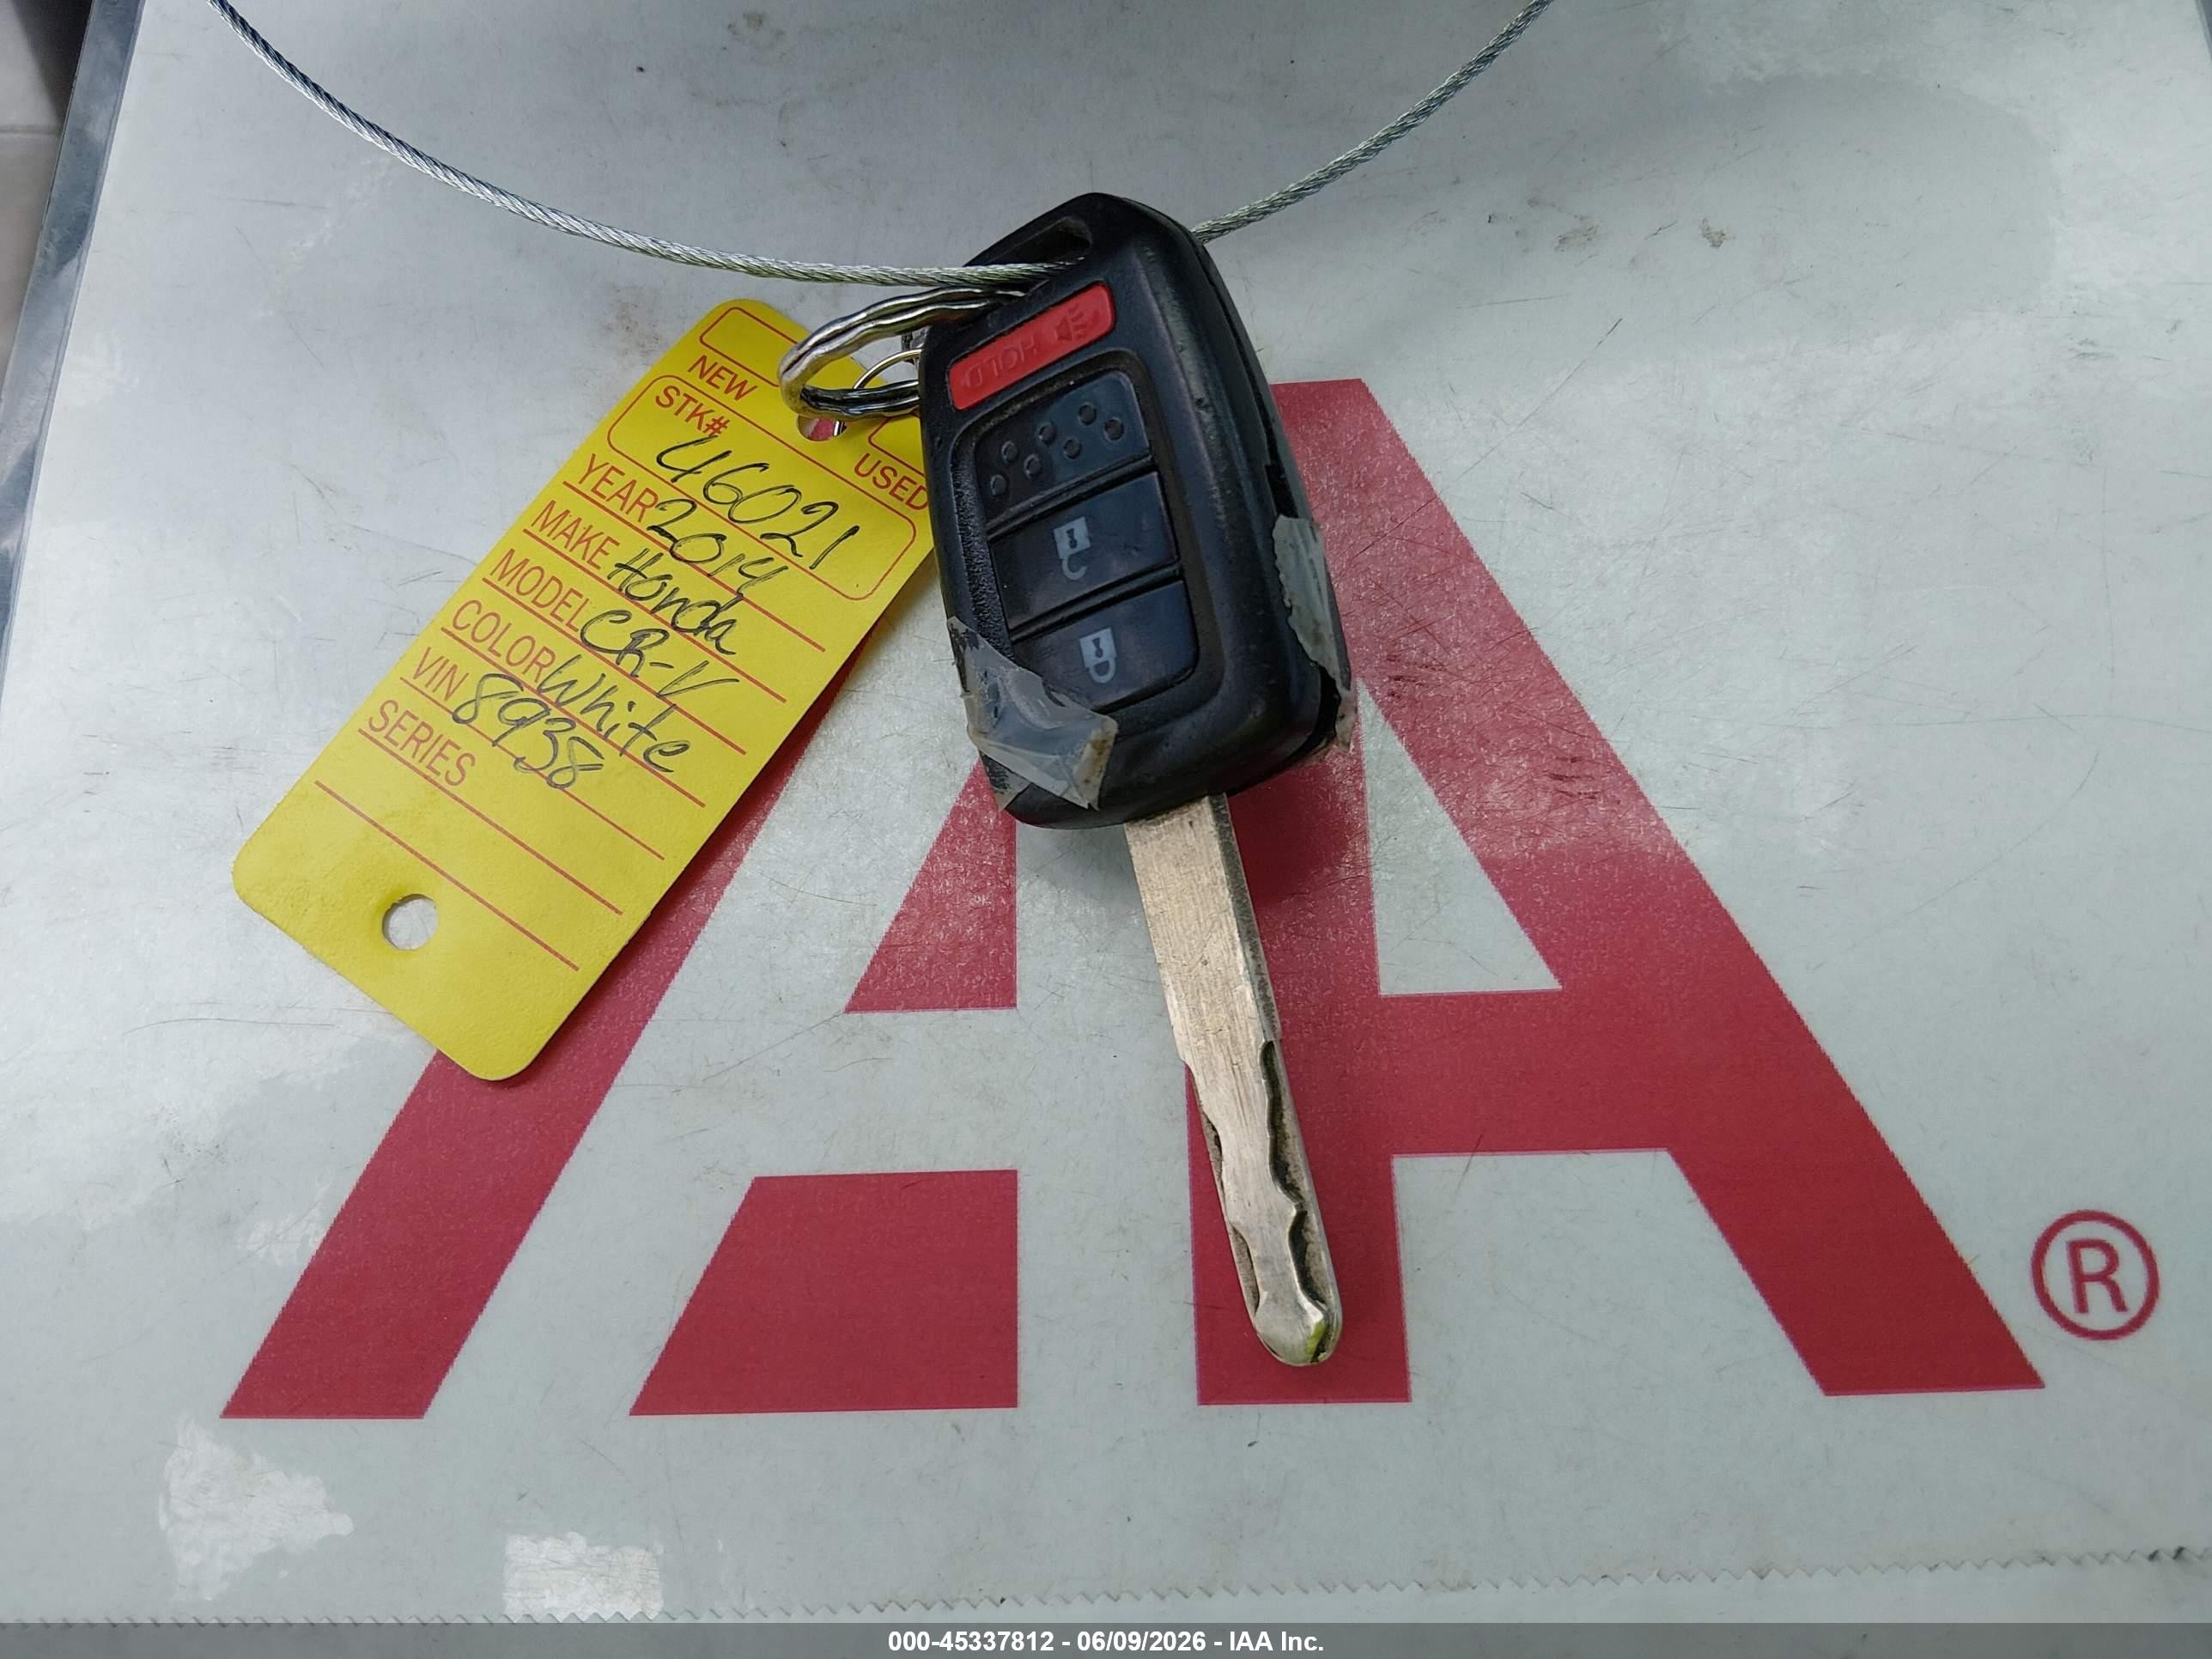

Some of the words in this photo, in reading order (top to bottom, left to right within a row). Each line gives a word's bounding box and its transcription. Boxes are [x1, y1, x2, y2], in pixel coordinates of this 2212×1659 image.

[655, 385, 729, 437] STK#
[687, 355, 758, 401] NEW
[578, 453, 659, 522] YEAR
[656, 435, 860, 569] 46021
[854, 453, 928, 511] USED
[531, 499, 621, 570] MAKE
[647, 498, 788, 599] 2014
[489, 548, 591, 633] MODEL
[607, 548, 738, 654] Honda
[413, 647, 470, 702] VIN
[452, 599, 556, 684] COLOR
[580, 609, 740, 699] CR-V
[368, 699, 477, 787] SERIES
[452, 673, 605, 789] 8938
[538, 654, 690, 773] White
